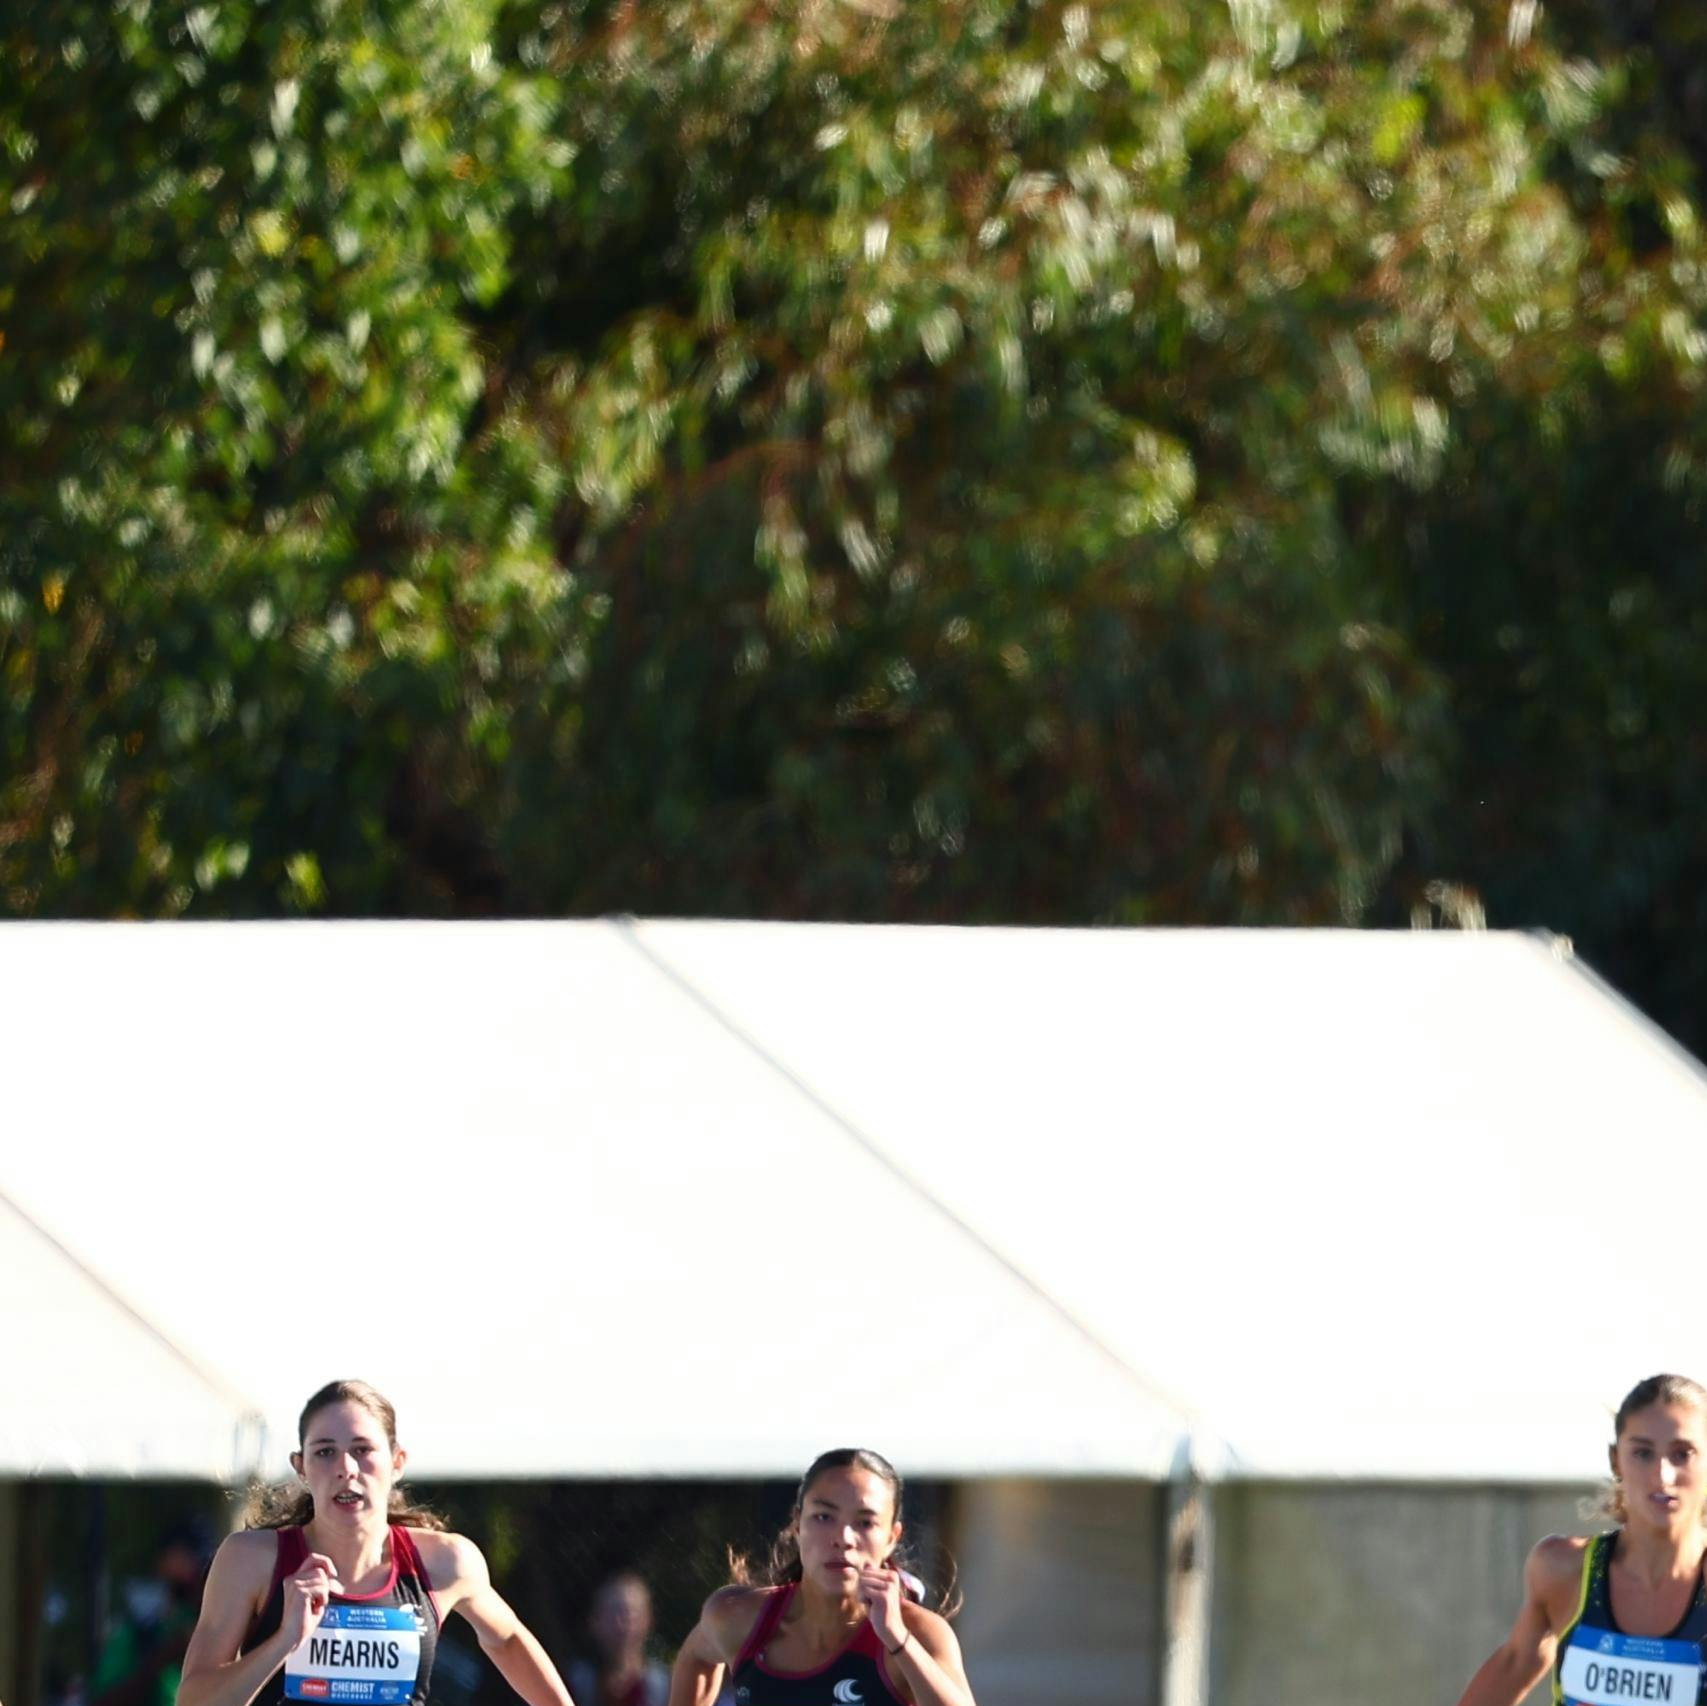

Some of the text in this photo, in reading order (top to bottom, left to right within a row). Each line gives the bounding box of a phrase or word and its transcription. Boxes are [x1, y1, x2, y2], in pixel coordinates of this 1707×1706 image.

[309, 1638, 399, 1669] MEARNS
[331, 1681, 374, 1693] CHEMIST
[1585, 1663, 1673, 1701] O'BRIEN
